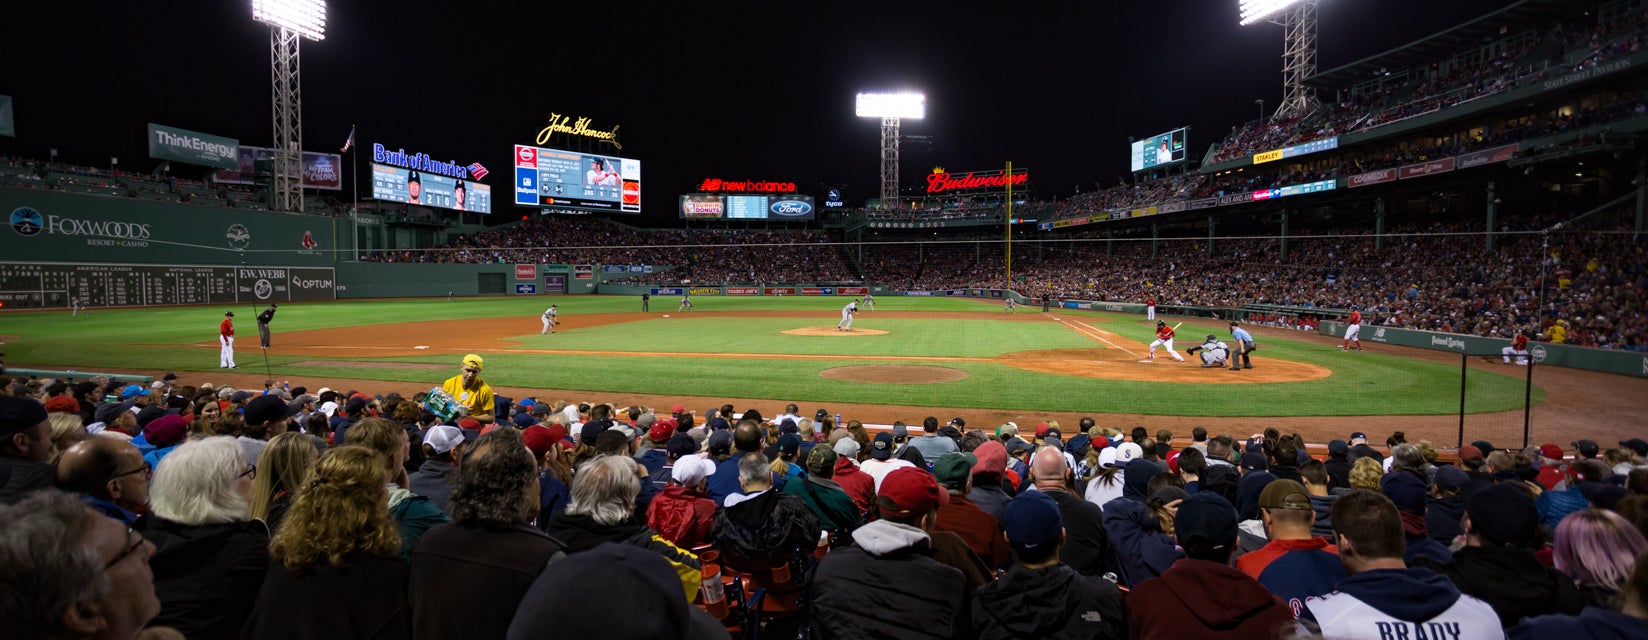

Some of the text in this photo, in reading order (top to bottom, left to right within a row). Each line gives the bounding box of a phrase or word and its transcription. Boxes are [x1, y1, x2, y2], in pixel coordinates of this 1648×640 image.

[1543, 57, 1631, 90] STATE STREET PAVILION
[536, 112, 622, 150] John Hancock
[155, 130, 233, 158] ThinkEnergy
[373, 143, 408, 168] Bank
[409, 152, 422, 170] of
[422, 154, 467, 179] America
[722, 182, 746, 191] new
[747, 180, 795, 192] balance
[926, 171, 1028, 193] Budweiser
[427, 194, 432, 204] 2
[445, 197, 449, 206] 0
[779, 203, 803, 213] Ford
[48, 214, 151, 239] FOXWOODS
[87, 238, 149, 248] RESORT CASINO
[239, 269, 286, 279] F.W. WEBB
[302, 279, 332, 289] OPTUM
[1431, 335, 1466, 350] Poland Spring
[1375, 621, 1462, 640] BRADY
